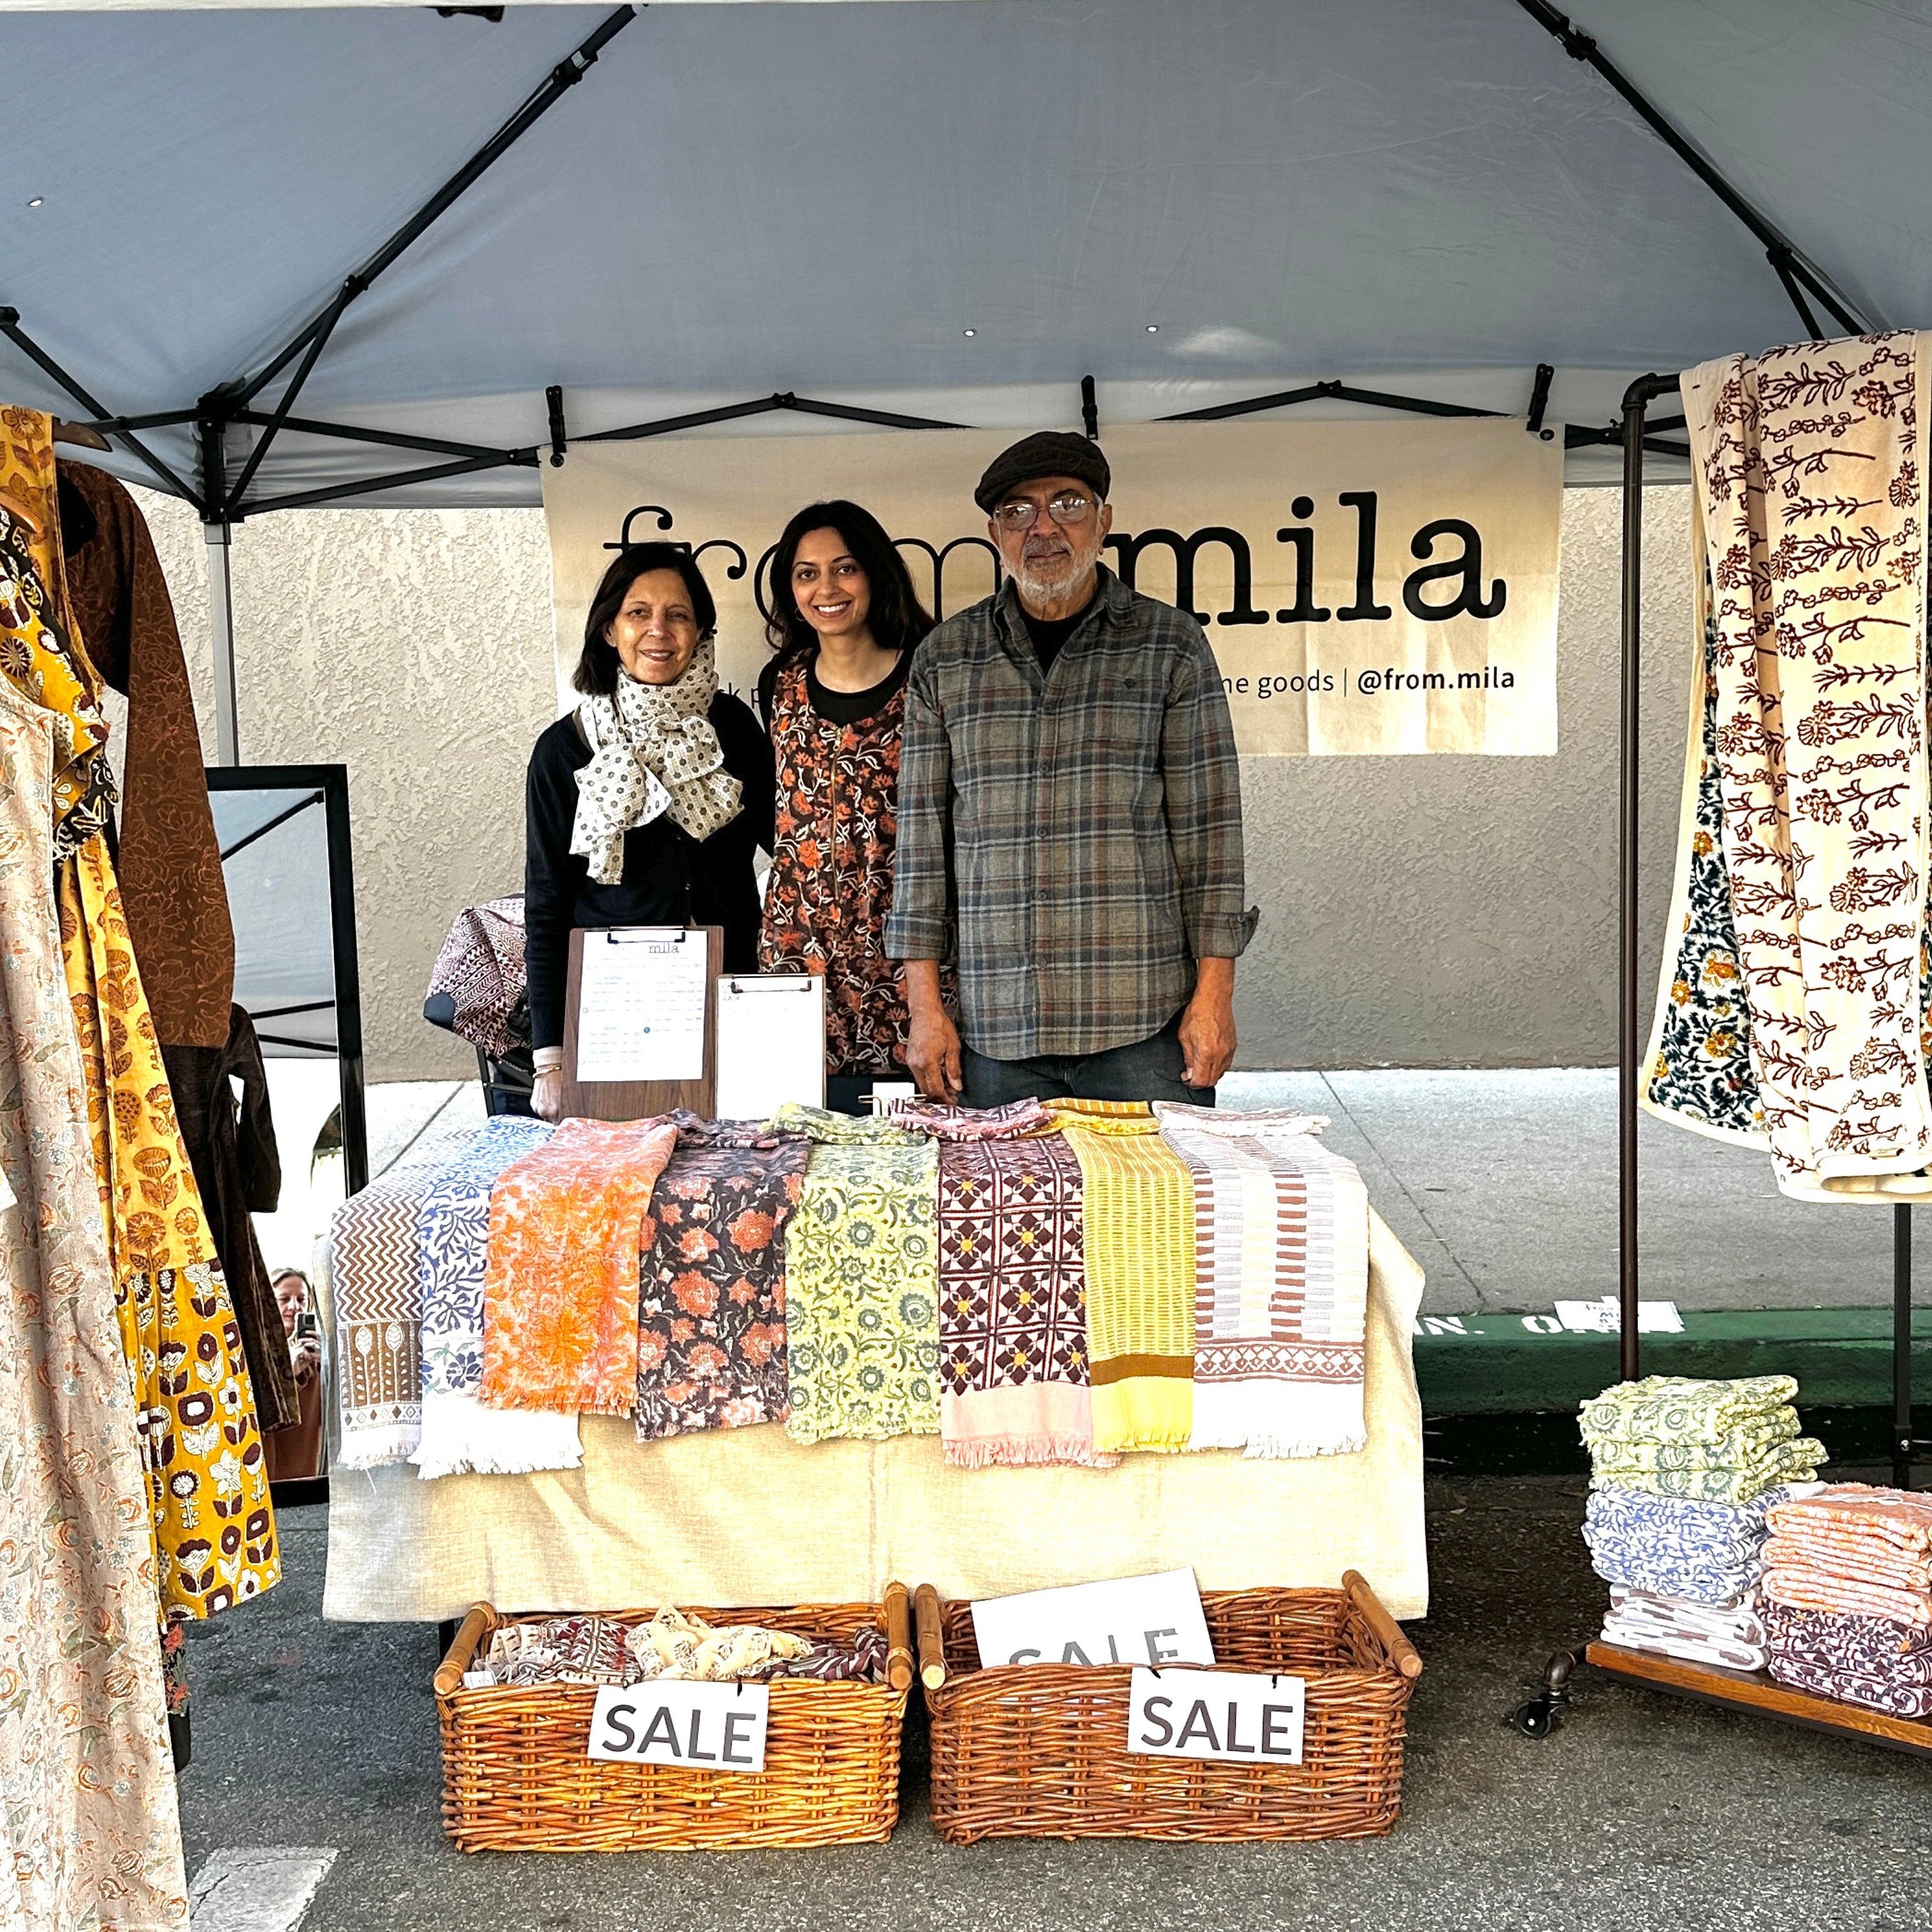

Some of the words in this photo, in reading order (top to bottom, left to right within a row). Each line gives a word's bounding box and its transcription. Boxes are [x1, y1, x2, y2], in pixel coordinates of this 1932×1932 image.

[1103, 491, 1506, 625] mila
[1257, 669, 1335, 700] goods
[1357, 666, 1515, 694] @from.mila
[602, 1704, 756, 1763] SALE
[1140, 1696, 1294, 1755] SALE
